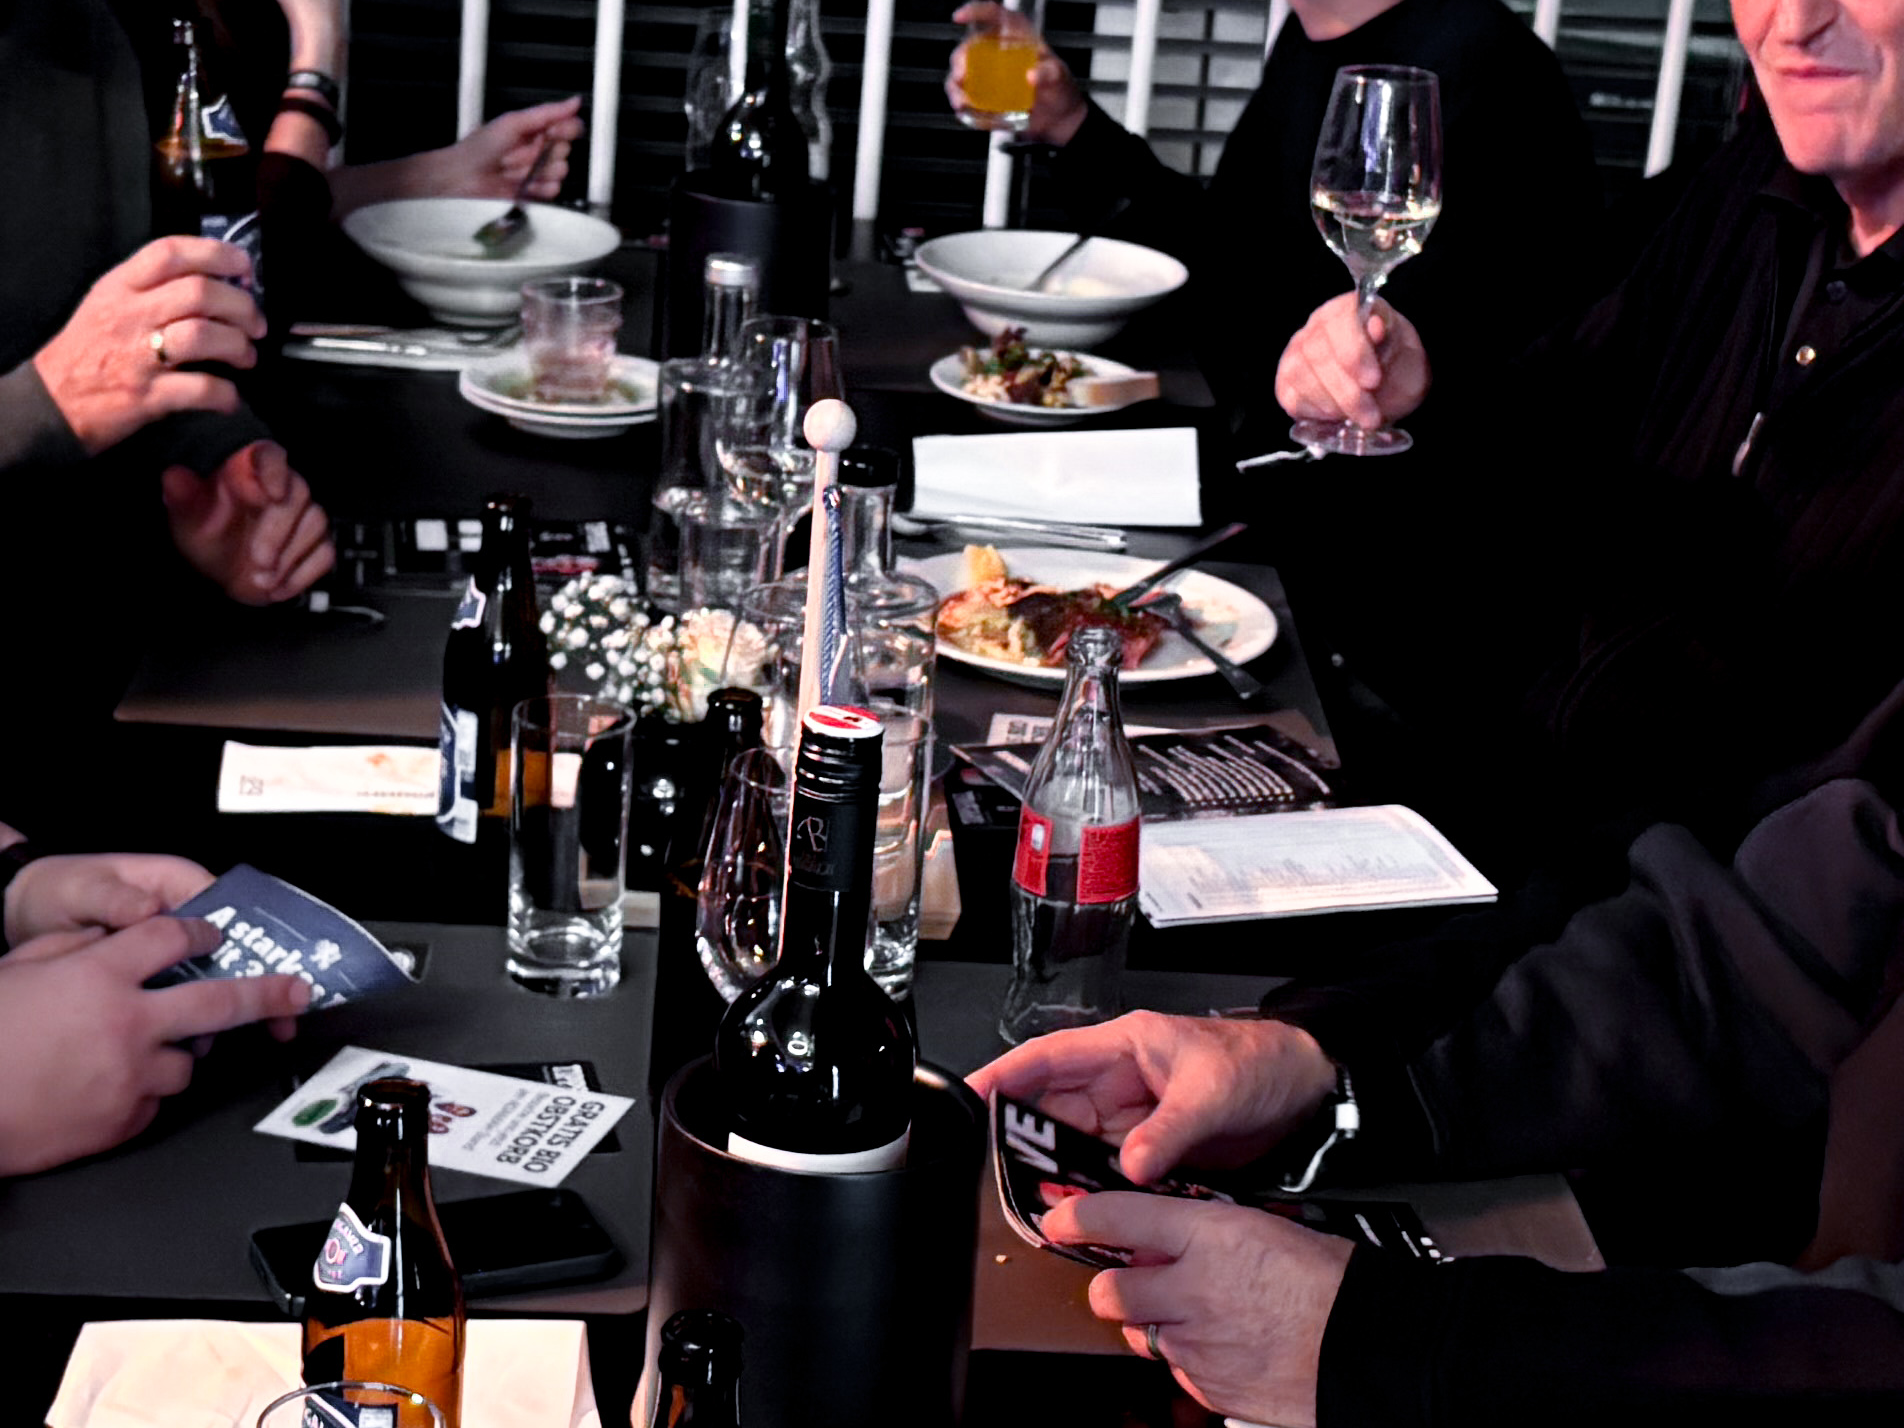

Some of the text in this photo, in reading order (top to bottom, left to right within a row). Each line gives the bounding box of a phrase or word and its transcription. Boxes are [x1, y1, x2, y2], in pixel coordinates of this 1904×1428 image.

[497, 1096, 576, 1164] OBSTKORB
[523, 1101, 605, 1173] GRATIS BIO
